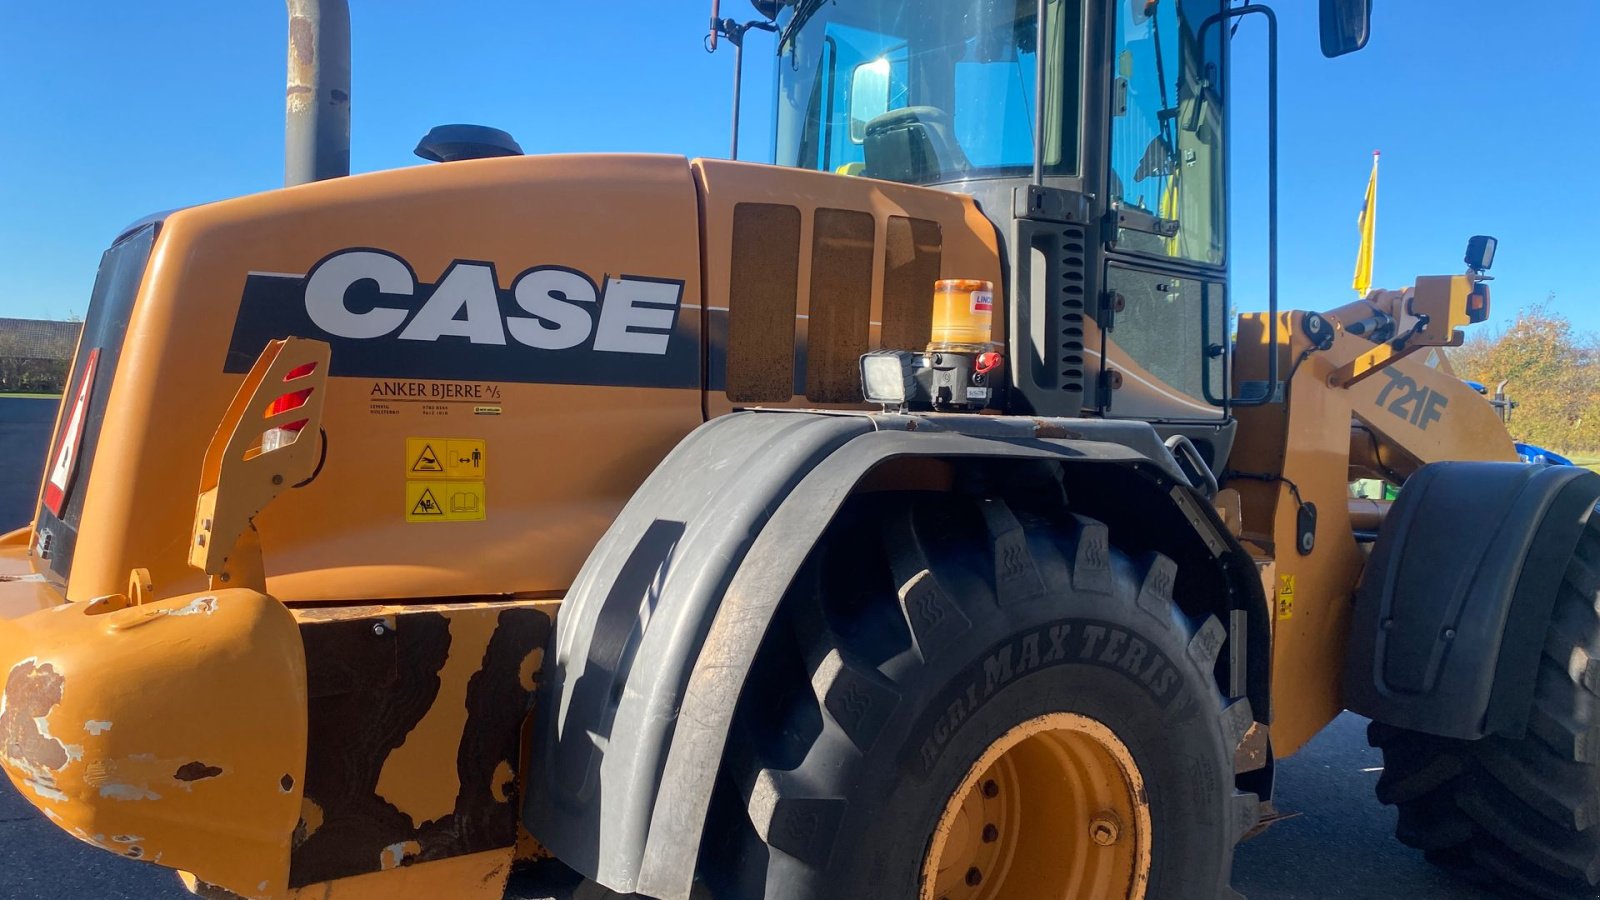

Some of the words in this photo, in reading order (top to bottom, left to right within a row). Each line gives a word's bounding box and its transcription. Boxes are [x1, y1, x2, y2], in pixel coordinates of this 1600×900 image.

[304, 251, 681, 355] CASE
[371, 382, 427, 396] ANKER
[431, 384, 482, 399] BJERRE
[485, 385, 501, 399] A/S
[1375, 365, 1449, 431] 721F
[921, 685, 979, 772] AGRI
[983, 625, 1071, 697] MAX
[1080, 626, 1178, 696] TERIS
